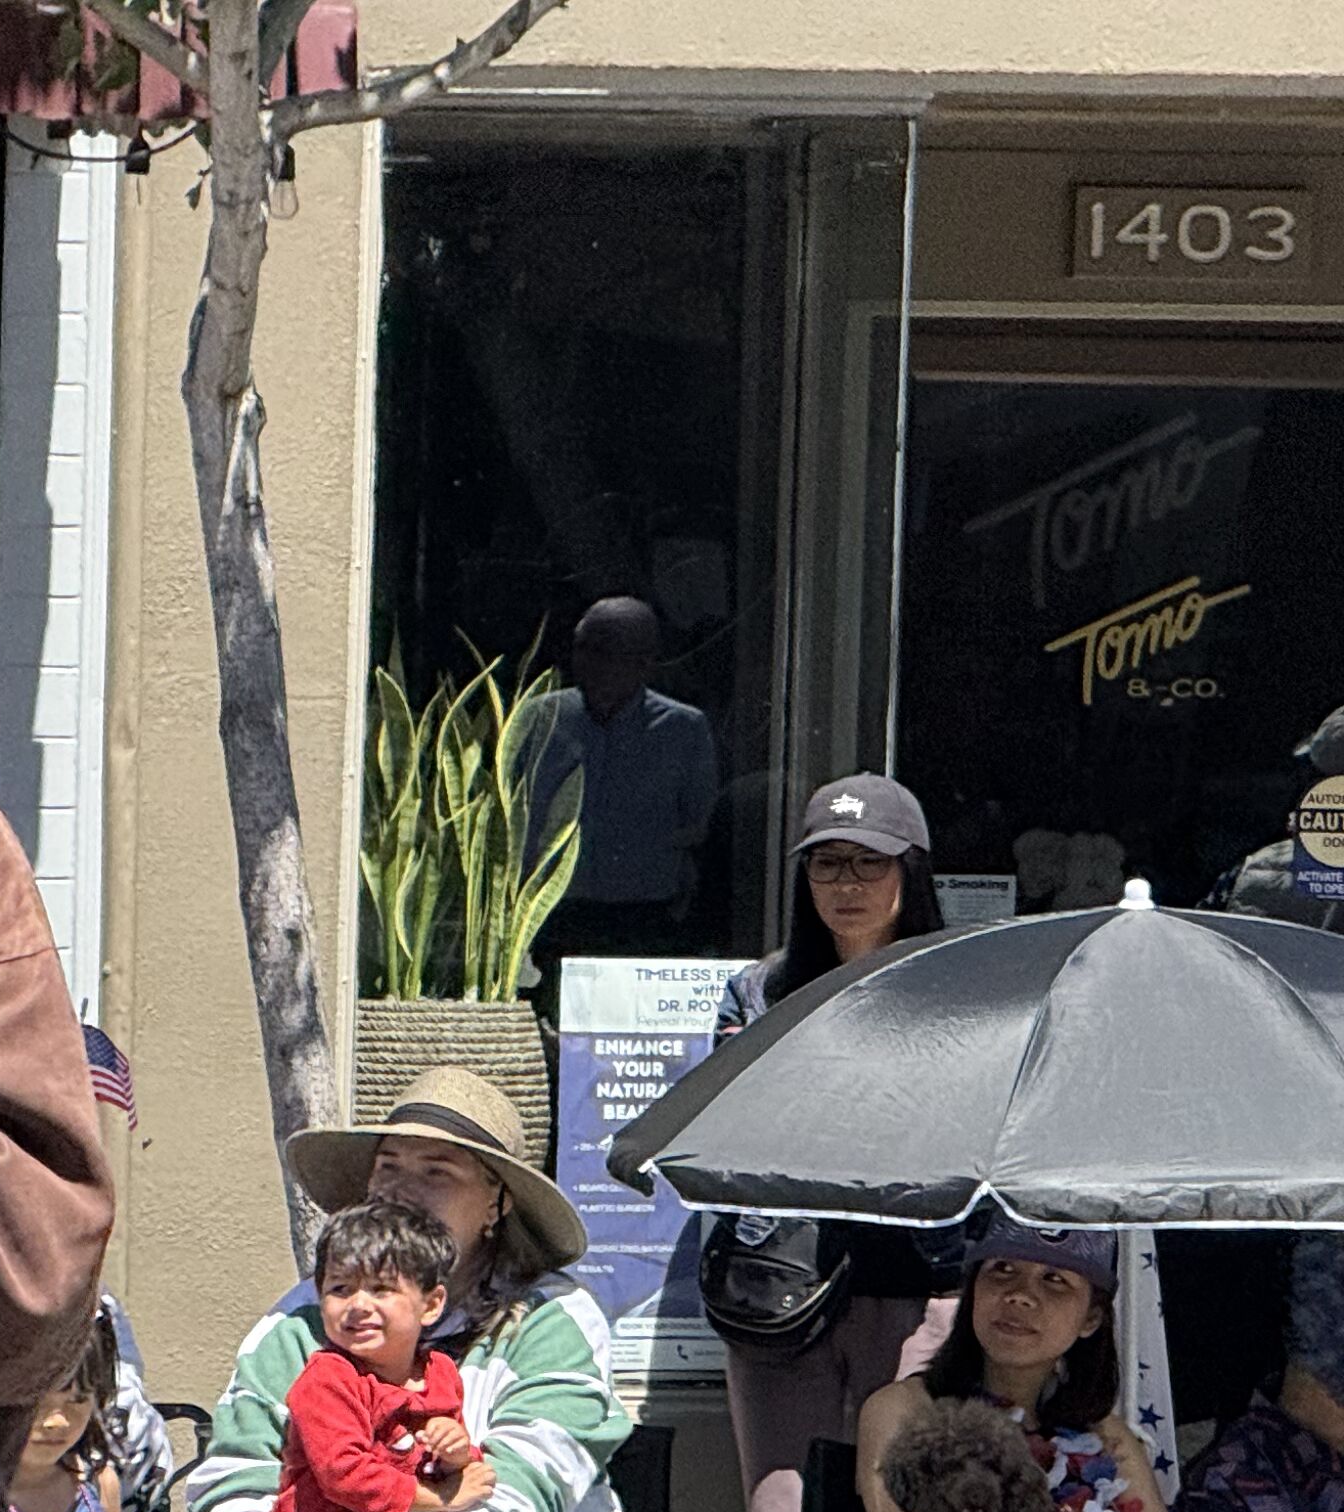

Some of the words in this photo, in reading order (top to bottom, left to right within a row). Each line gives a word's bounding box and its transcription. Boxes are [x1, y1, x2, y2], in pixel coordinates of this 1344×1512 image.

[1087, 200, 1298, 265] 1403
[1043, 575, 1253, 706] Tomo
[948, 878, 1009, 892] Smoking
[635, 967, 711, 981] TIMELESS
[657, 999, 683, 1012] DR.
[594, 1040, 685, 1056] ENHANCE
[613, 1061, 665, 1078] YOUR
[595, 1082, 674, 1099] NATURA
